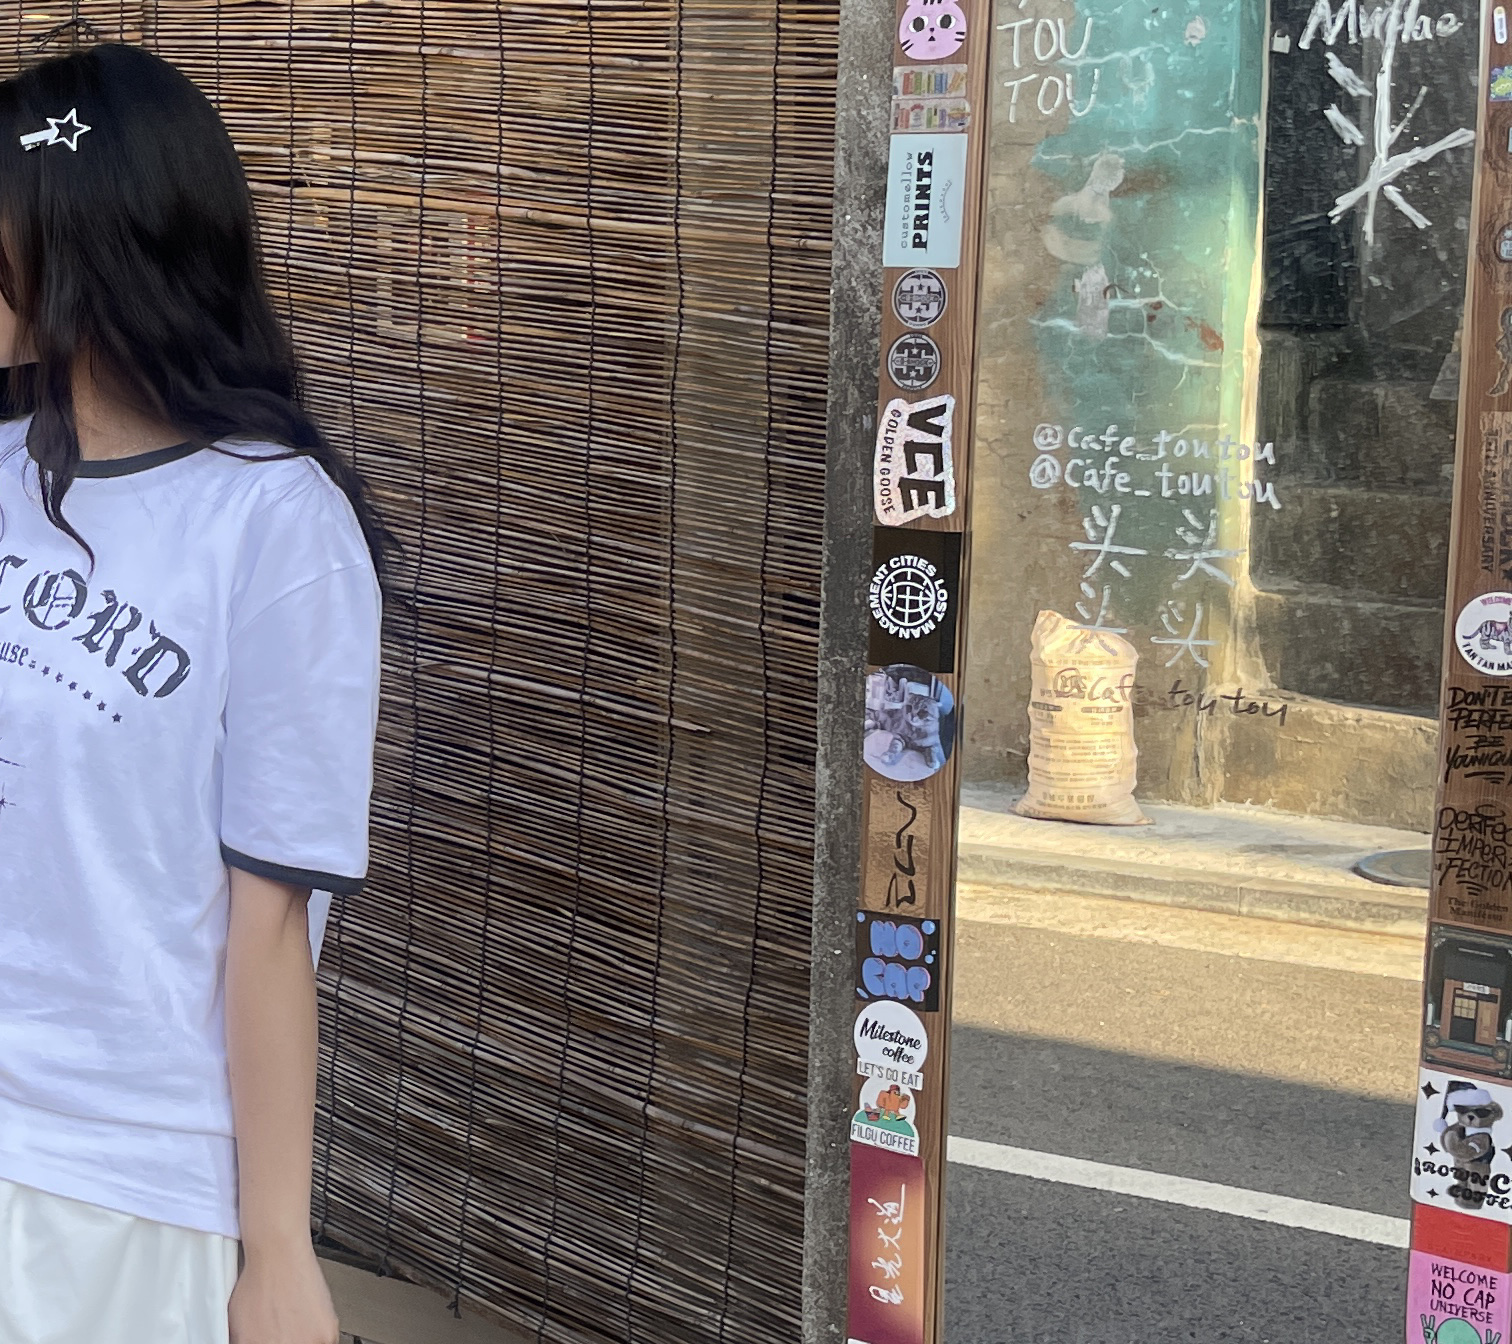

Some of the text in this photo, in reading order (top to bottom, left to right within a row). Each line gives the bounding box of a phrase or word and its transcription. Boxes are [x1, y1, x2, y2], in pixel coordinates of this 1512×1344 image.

[996, 16, 1094, 68] TOU
[1003, 67, 1100, 124] TOU
[900, 152, 913, 249] customellow
[912, 150, 934, 249] PRINTS
[878, 408, 902, 514] GOLDEN GOOSE
[869, 555, 949, 639] LOST MANAGEMENT CITIES
[1462, 642, 1478, 661] TAN
[1477, 657, 1495, 670] TAN
[859, 1017, 922, 1050] Milestone
[882, 1046, 915, 1065] coffee
[858, 1060, 920, 1088] LET'S GO EAT
[880, 1131, 916, 1153] COFFEE
[1431, 1262, 1498, 1291] WELCOME
[1431, 1279, 1496, 1310] NO CAP
[1430, 1299, 1494, 1325] UNIVERSE
